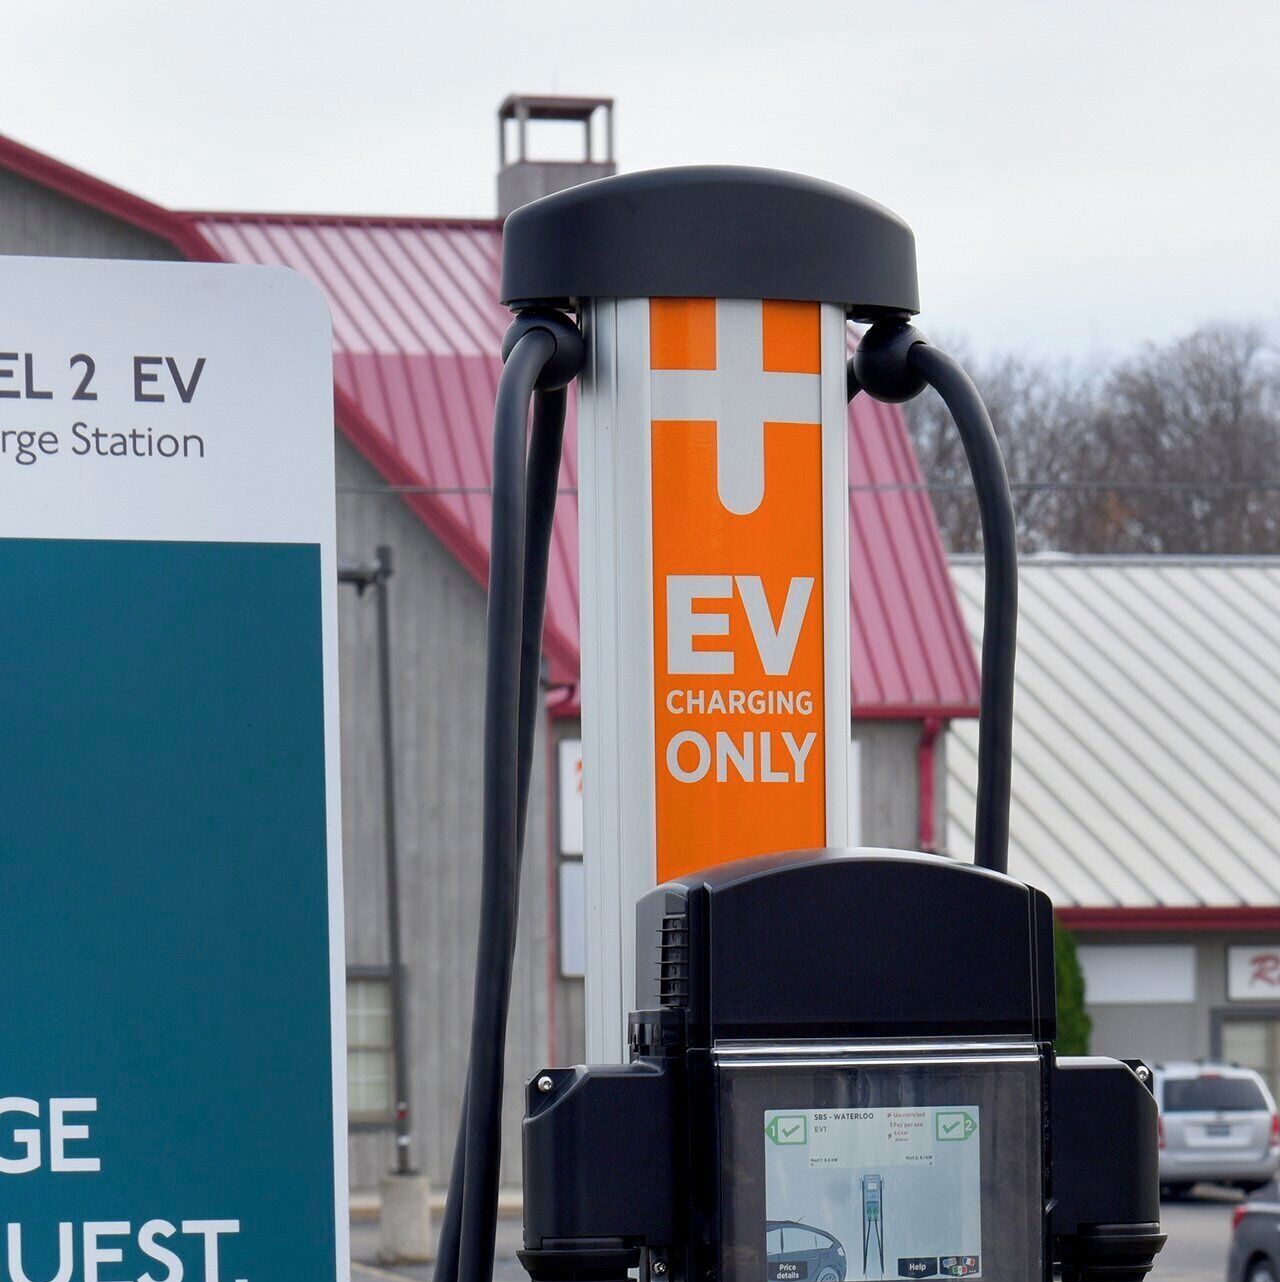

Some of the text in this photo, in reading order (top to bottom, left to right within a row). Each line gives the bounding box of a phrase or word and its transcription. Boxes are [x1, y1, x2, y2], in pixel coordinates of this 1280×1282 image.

[69, 353, 98, 402] 2
[133, 355, 207, 404] EV
[70, 420, 206, 459] Station
[666, 574, 816, 676] EV
[666, 689, 814, 715] CHARGING
[665, 730, 817, 784] ONLY
[833, 1112, 874, 1121] WATERLOO
[965, 1119, 972, 1131] 2
[776, 1271, 800, 1280] details
[909, 1263, 927, 1272] Help
